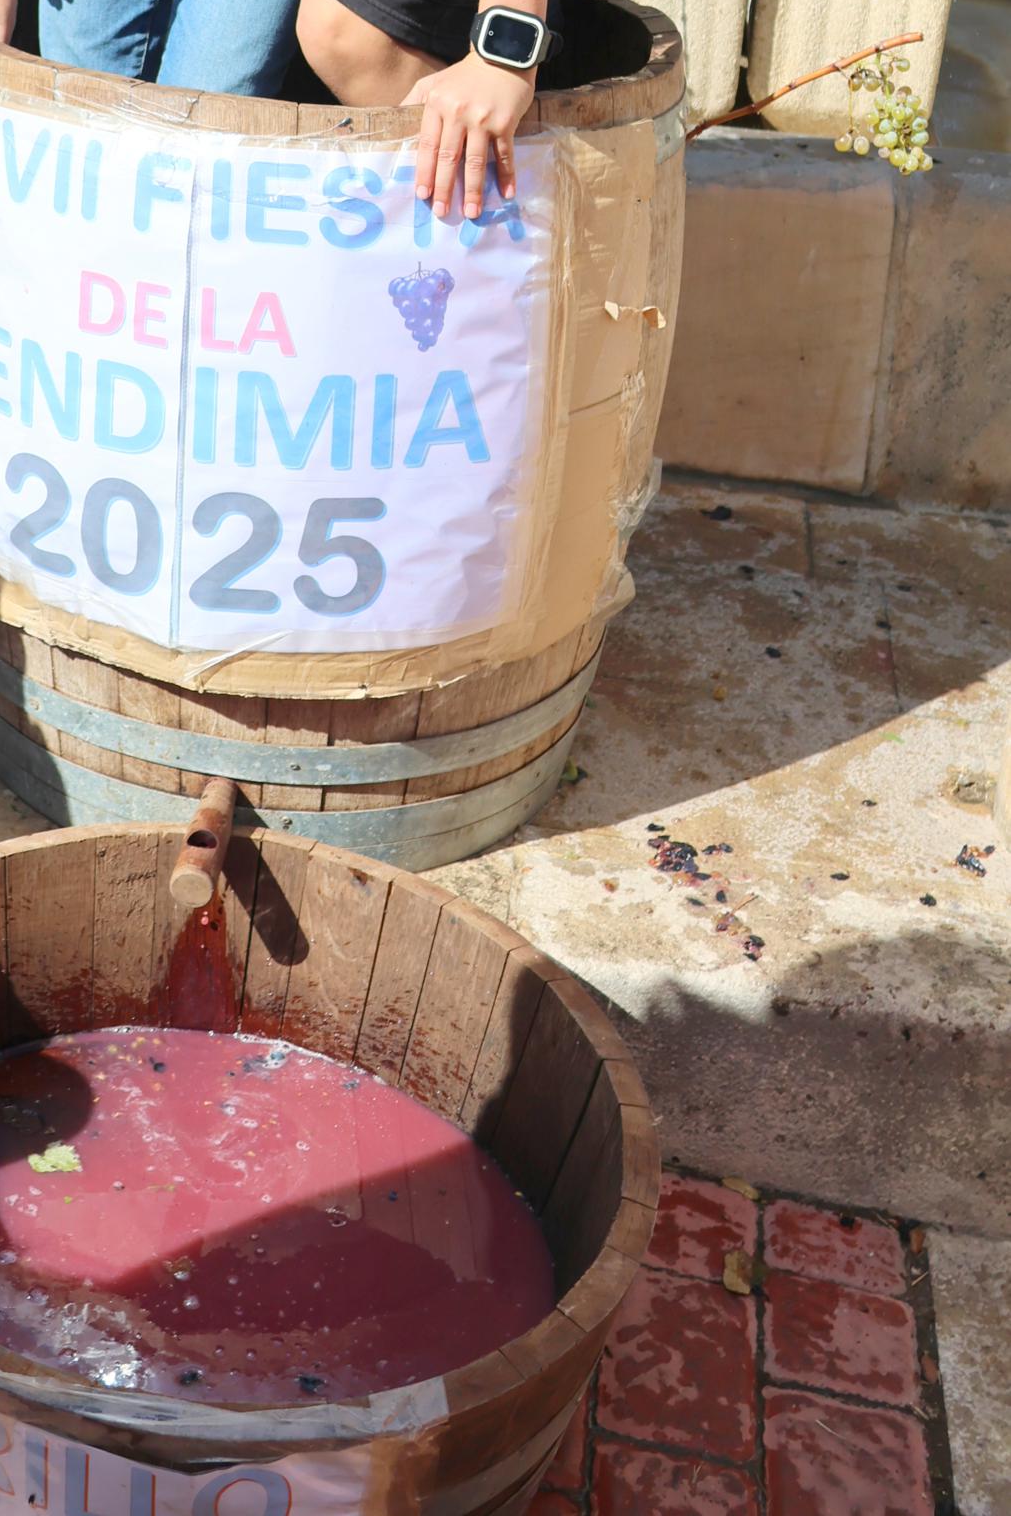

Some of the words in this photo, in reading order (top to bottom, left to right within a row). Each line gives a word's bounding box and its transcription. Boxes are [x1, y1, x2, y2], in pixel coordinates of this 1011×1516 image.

[77, 269, 172, 350] DE
[199, 286, 297, 358] LA
[4, 451, 389, 618] 2025
